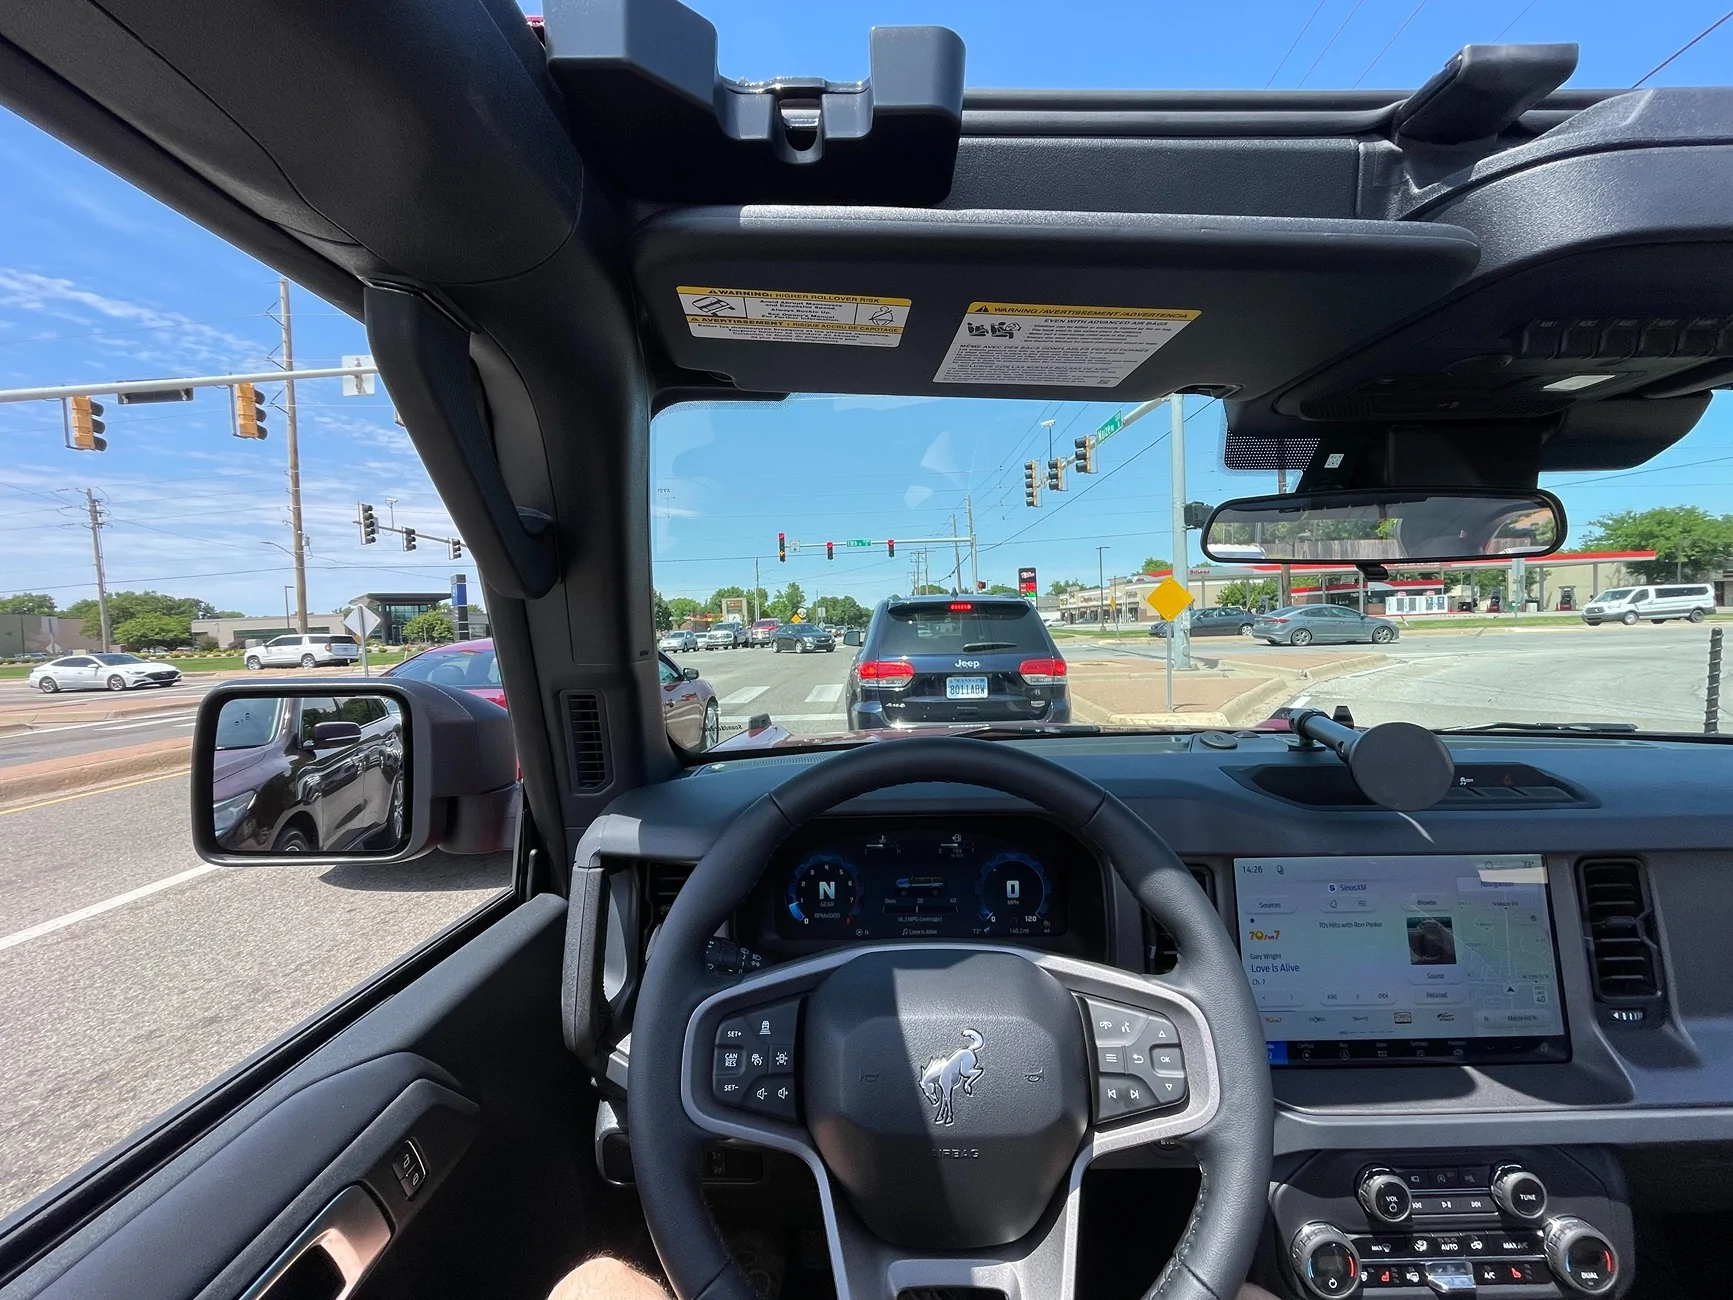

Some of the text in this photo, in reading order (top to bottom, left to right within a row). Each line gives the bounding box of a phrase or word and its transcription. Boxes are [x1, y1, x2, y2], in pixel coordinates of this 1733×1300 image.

[718, 289, 773, 298] WARNING:
[811, 293, 858, 302] ROLLOVER
[701, 317, 784, 326] AVERTISSEMENT
[954, 658, 981, 669] Jeep
[950, 684, 985, 695] 8011ABW
[1242, 866, 1263, 874] 14:26
[819, 881, 835, 900] N
[1006, 880, 1020, 898] 0
[1340, 884, 1367, 892] SiriusXM
[1251, 963, 1300, 973] Love Is Alive
[1536, 995, 1546, 1003] 40
[727, 1030, 742, 1038] SET+
[723, 1084, 739, 1092] SET-
[1385, 1195, 1399, 1203] VOL
[1519, 1193, 1537, 1201] TUNE
[1441, 1243, 1459, 1251] AUTO
[1517, 1241, 1529, 1249] A/C
[1484, 1271, 1496, 1280] A/C
[1580, 1271, 1599, 1280] DUAL
